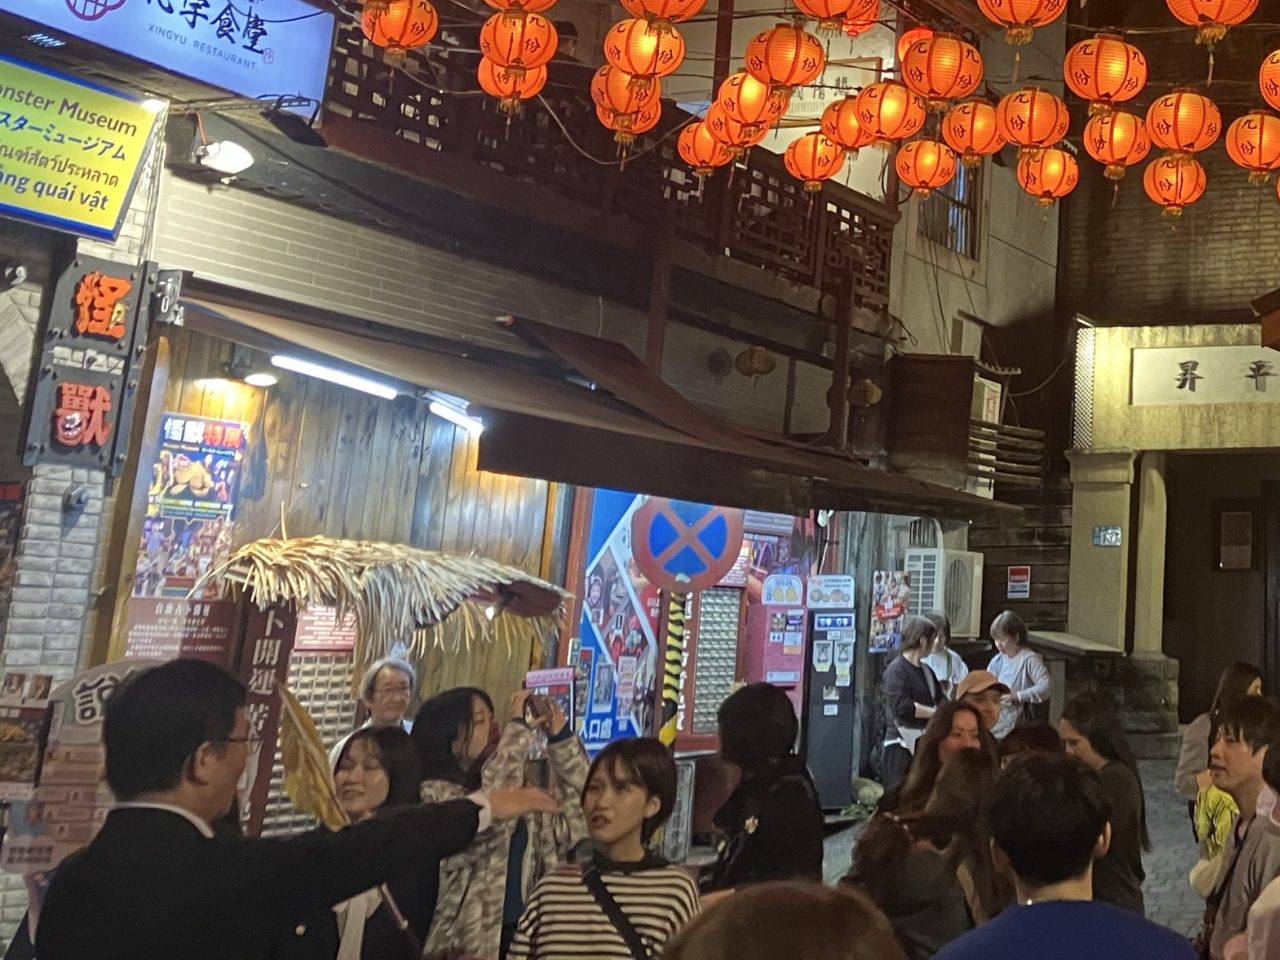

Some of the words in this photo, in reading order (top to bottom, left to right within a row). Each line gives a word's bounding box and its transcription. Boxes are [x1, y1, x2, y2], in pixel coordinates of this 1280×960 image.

[147, 23, 188, 45] XINGYU
[193, 40, 257, 71] RESTAURANT
[0, 83, 55, 111] nster
[58, 98, 137, 137] Museum
[0, 139, 119, 188] ณฑ์สัตว์ประหลาด
[33, 181, 76, 201] quái
[81, 191, 109, 213] vật
